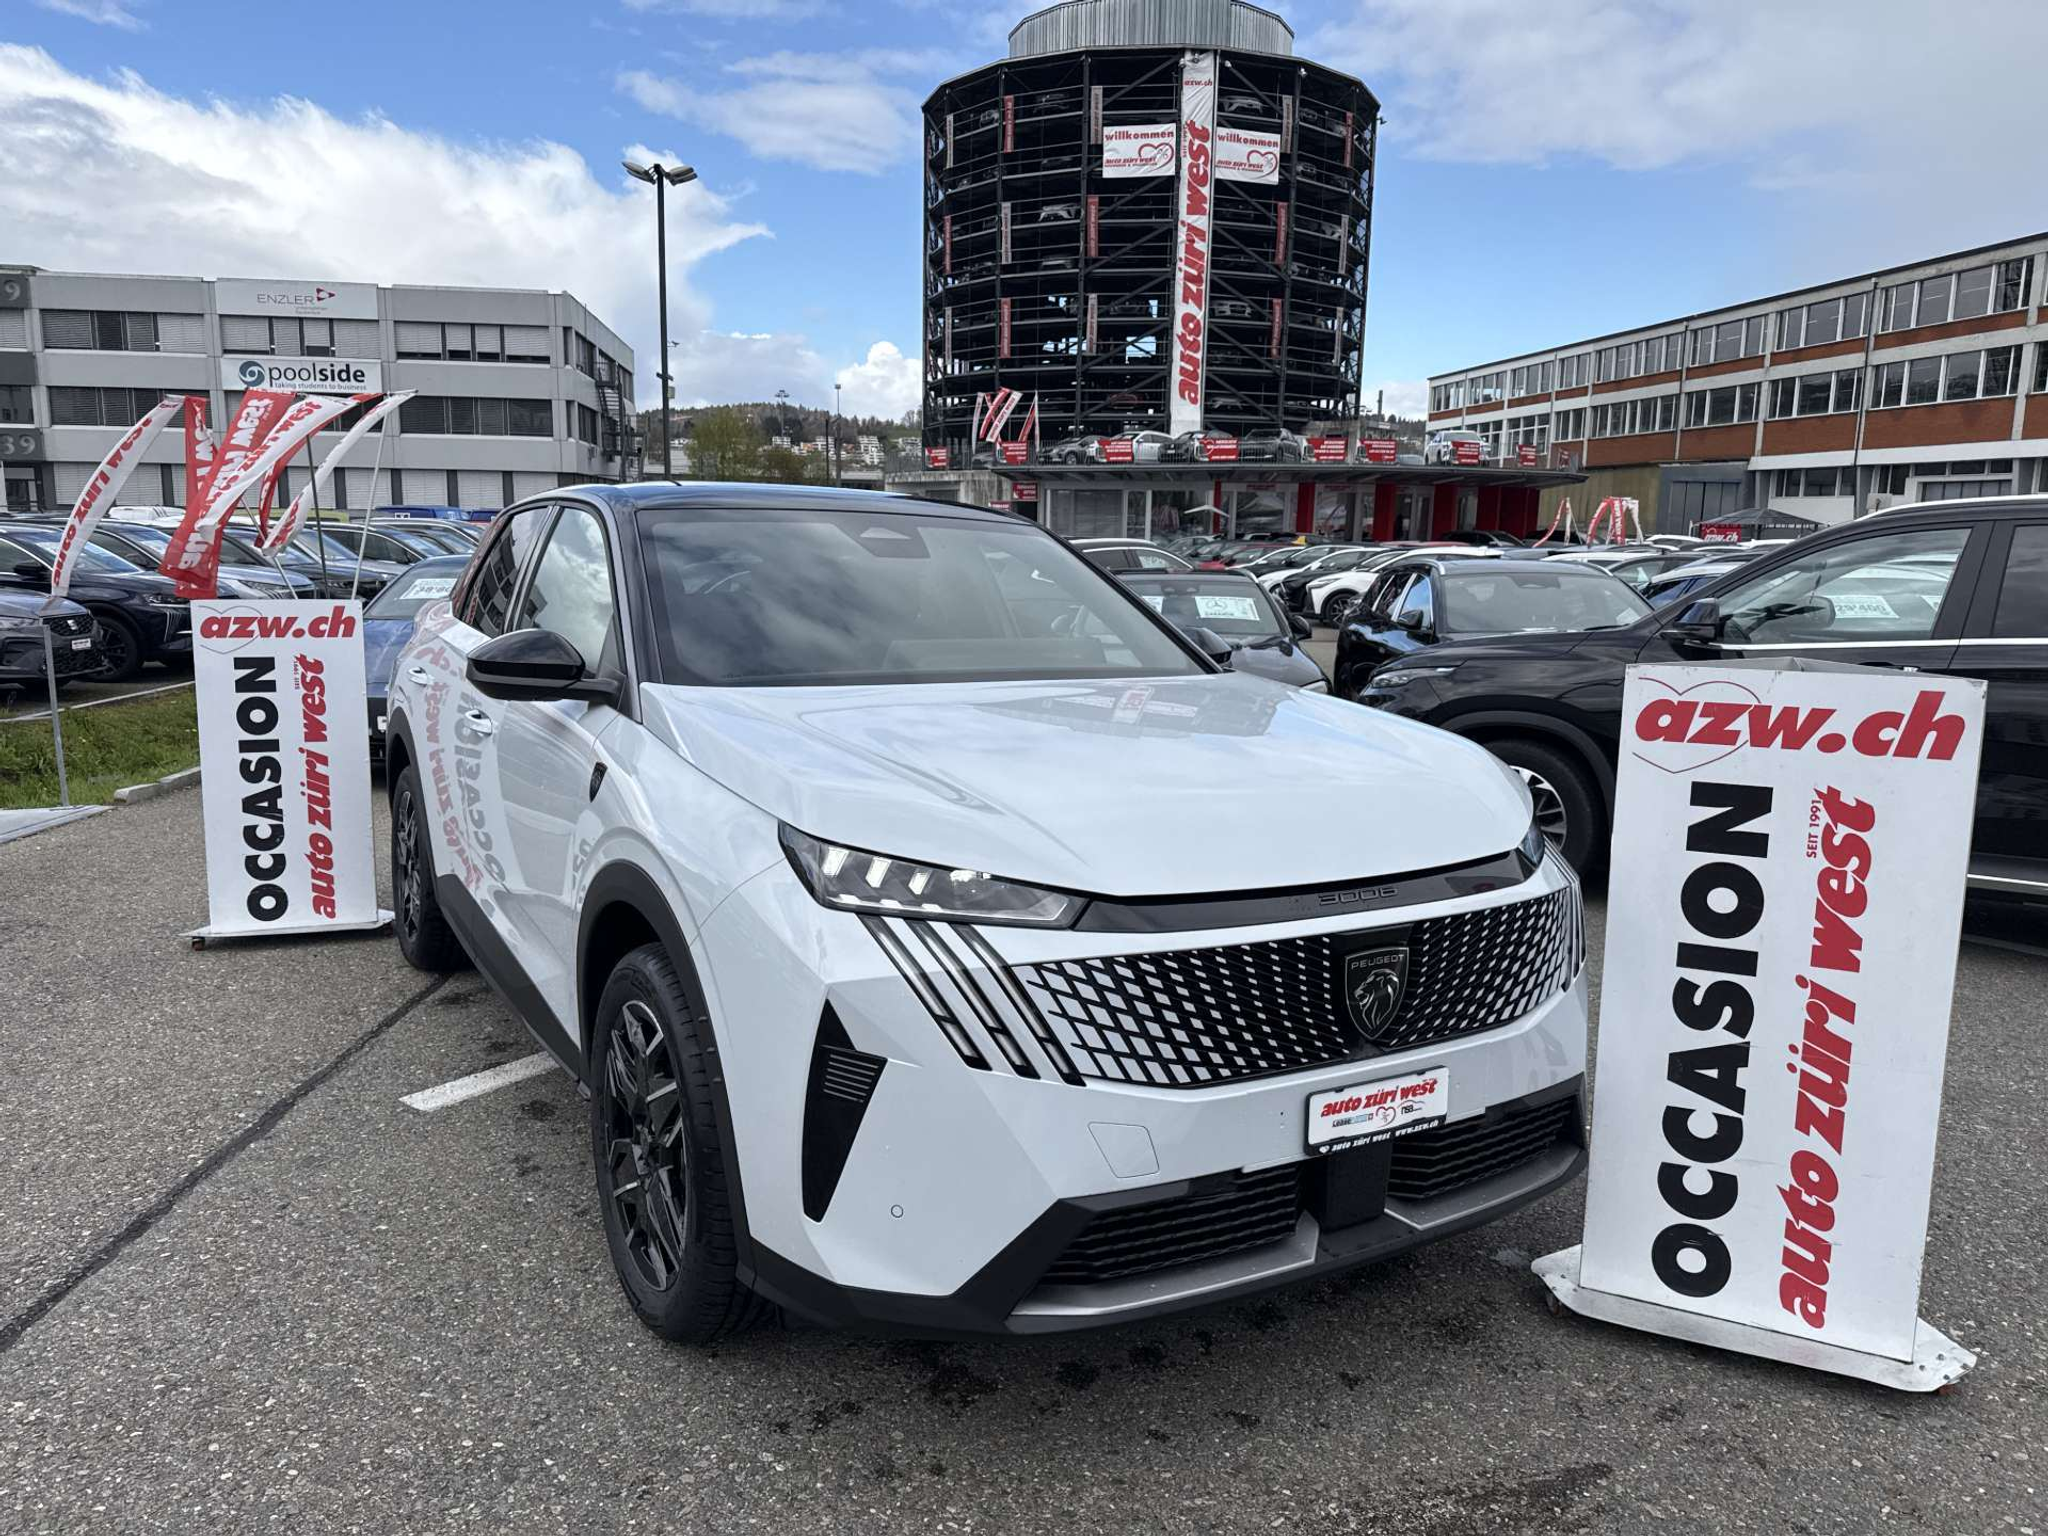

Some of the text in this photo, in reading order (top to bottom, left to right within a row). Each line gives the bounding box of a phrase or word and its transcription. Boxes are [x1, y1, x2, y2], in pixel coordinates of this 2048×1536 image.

[1105, 130, 1175, 141] willkommen
[1217, 133, 1279, 148] willkommen
[1176, 119, 1211, 406] auto züri west
[257, 293, 315, 305] ENZLER
[268, 362, 365, 388] poolside
[275, 382, 296, 390] taking
[298, 382, 328, 390] students
[338, 383, 367, 391] business
[200, 606, 356, 639] azw.ch
[1635, 690, 1966, 761] azw.ch
[233, 656, 289, 922] OCCASION
[294, 653, 336, 919] auto züri west
[1806, 799, 1822, 859] SEIT 1991
[1351, 953, 1404, 971] PEUGEOT
[1651, 781, 1774, 1298] OCCASION
[1776, 785, 1876, 1329] auto züri west
[1320, 1078, 1438, 1118] auto züri west
[1331, 1119, 1439, 1152] auto züri west www.azw.ch
